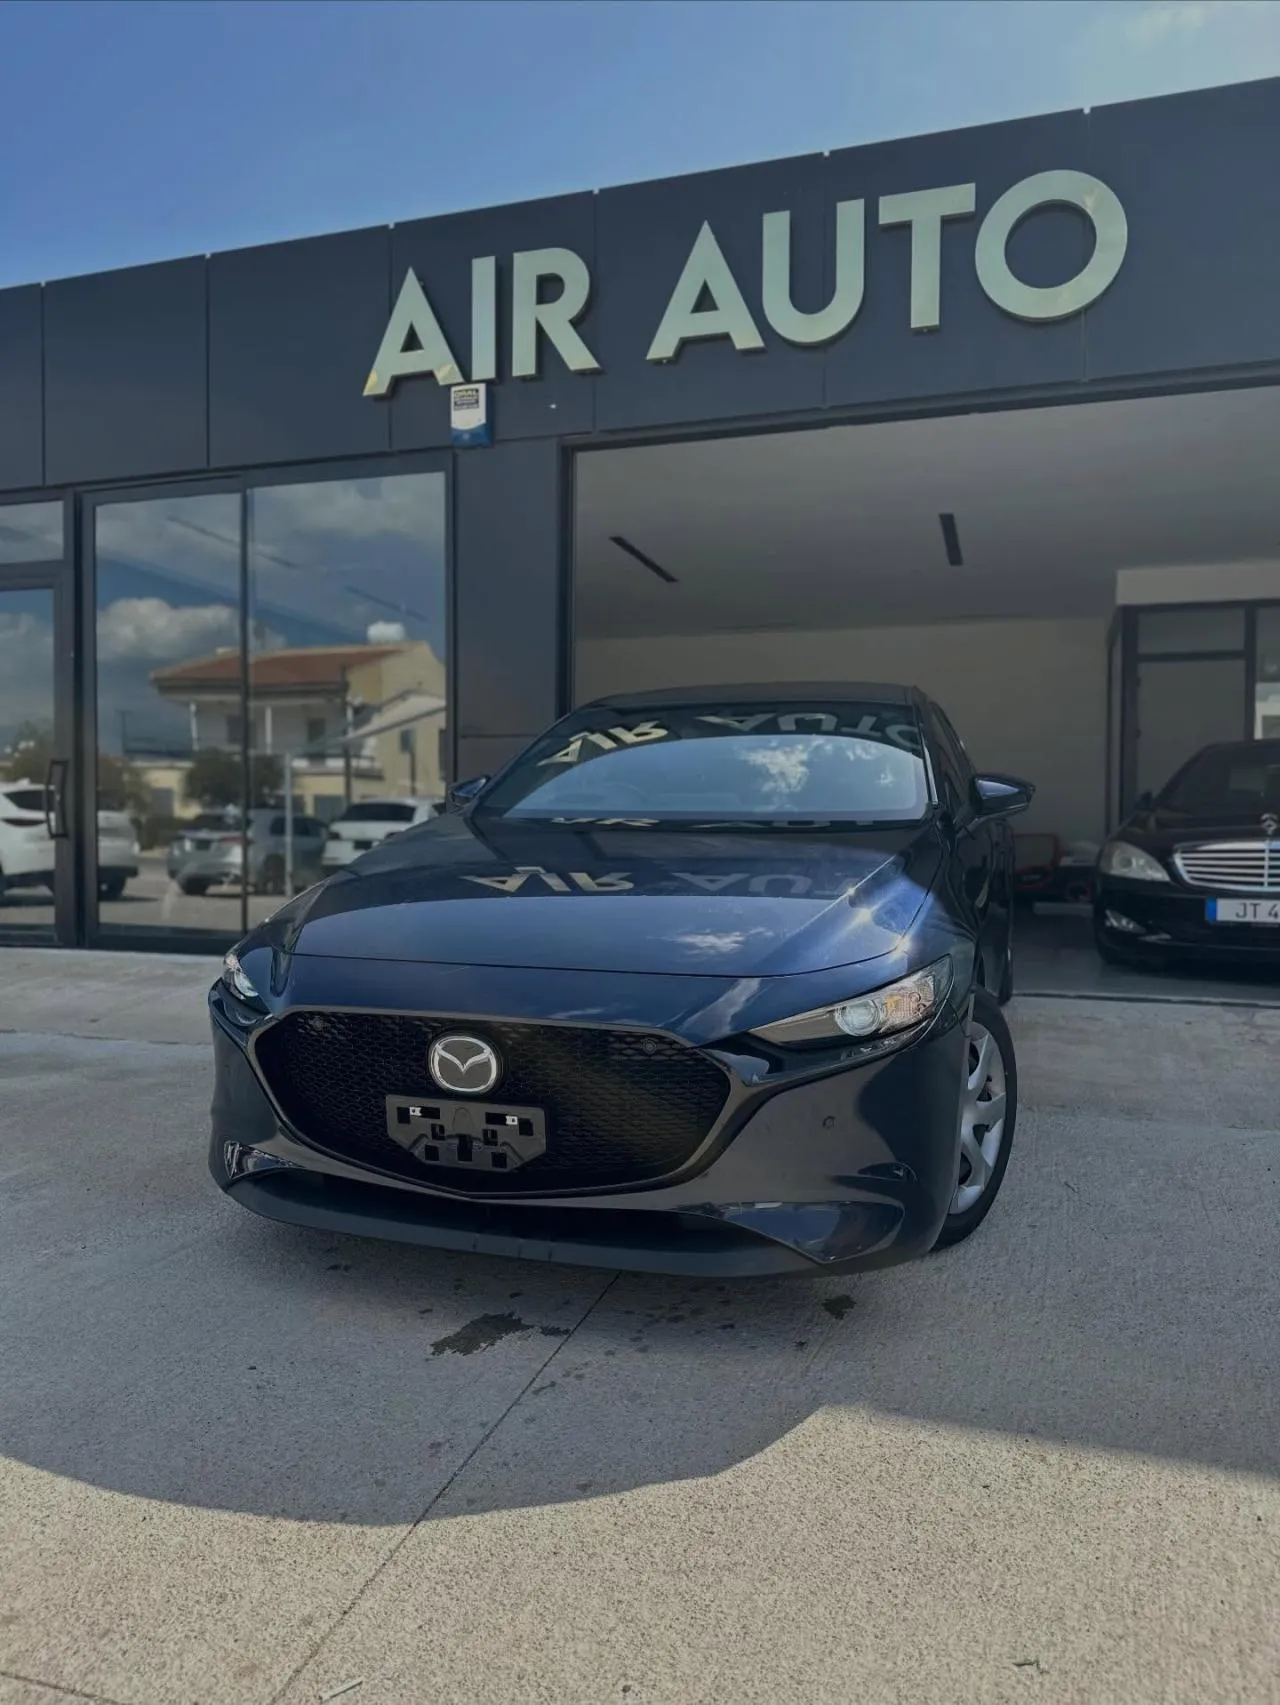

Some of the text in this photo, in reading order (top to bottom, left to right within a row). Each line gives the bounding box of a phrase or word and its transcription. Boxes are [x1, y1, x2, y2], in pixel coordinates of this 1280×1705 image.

[362, 169, 1129, 397] AIR AUTO
[1235, 902, 1261, 919] JT
